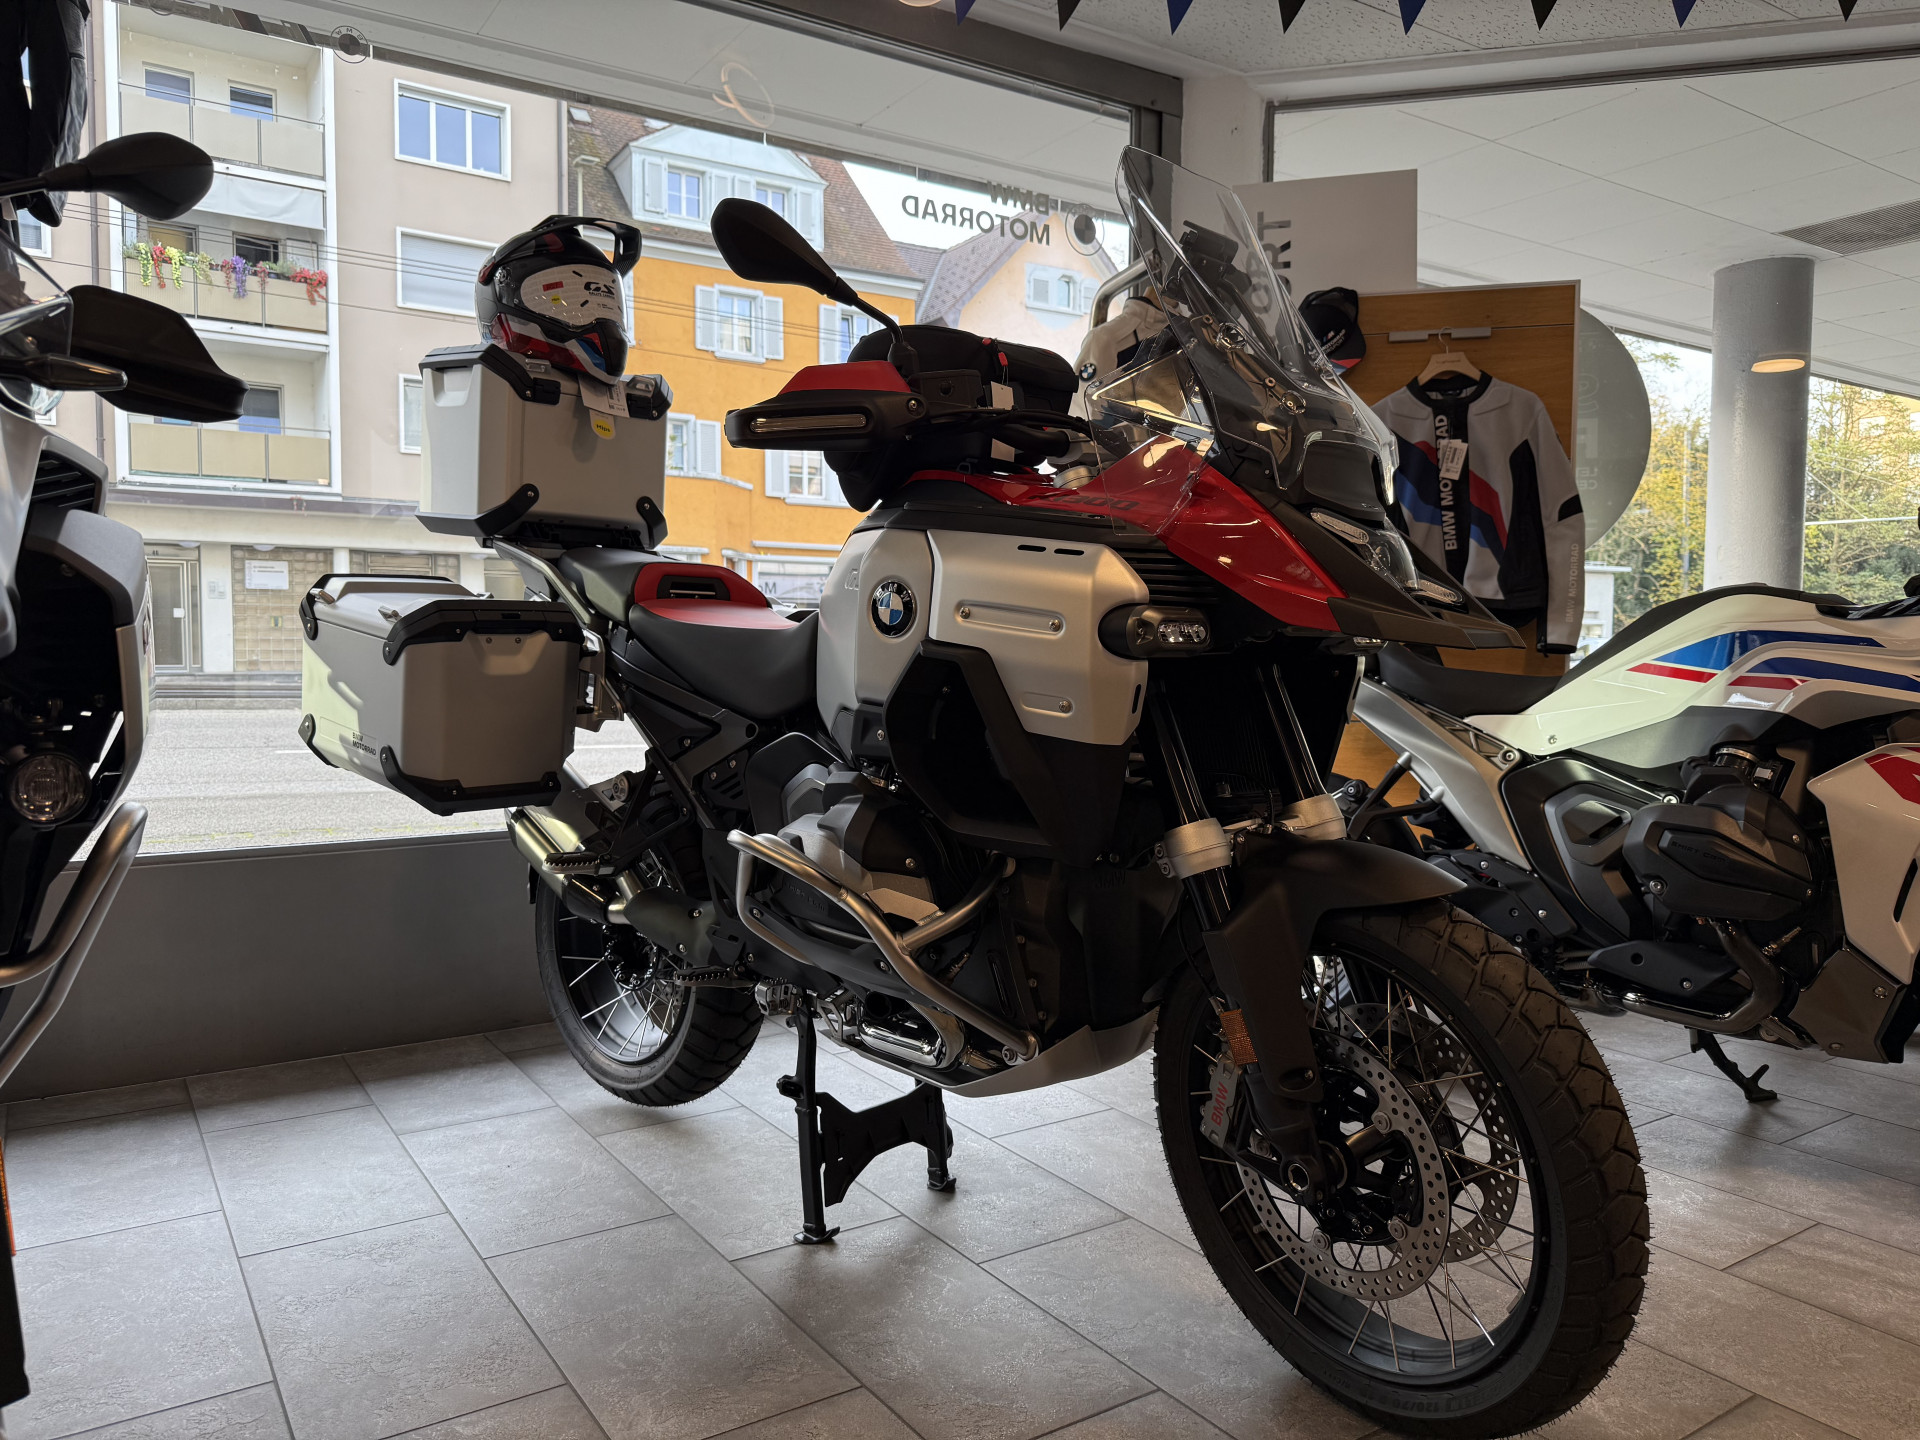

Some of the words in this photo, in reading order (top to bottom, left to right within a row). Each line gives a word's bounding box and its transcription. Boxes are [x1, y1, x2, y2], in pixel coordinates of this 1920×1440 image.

[583, 281, 615, 296] GS
[596, 423, 611, 433] Mips
[1441, 510, 1459, 551] BMW
[1567, 543, 1580, 598] MOTORRAD
[352, 739, 377, 756] MOTORRAD
[1211, 1081, 1229, 1127] BMW
